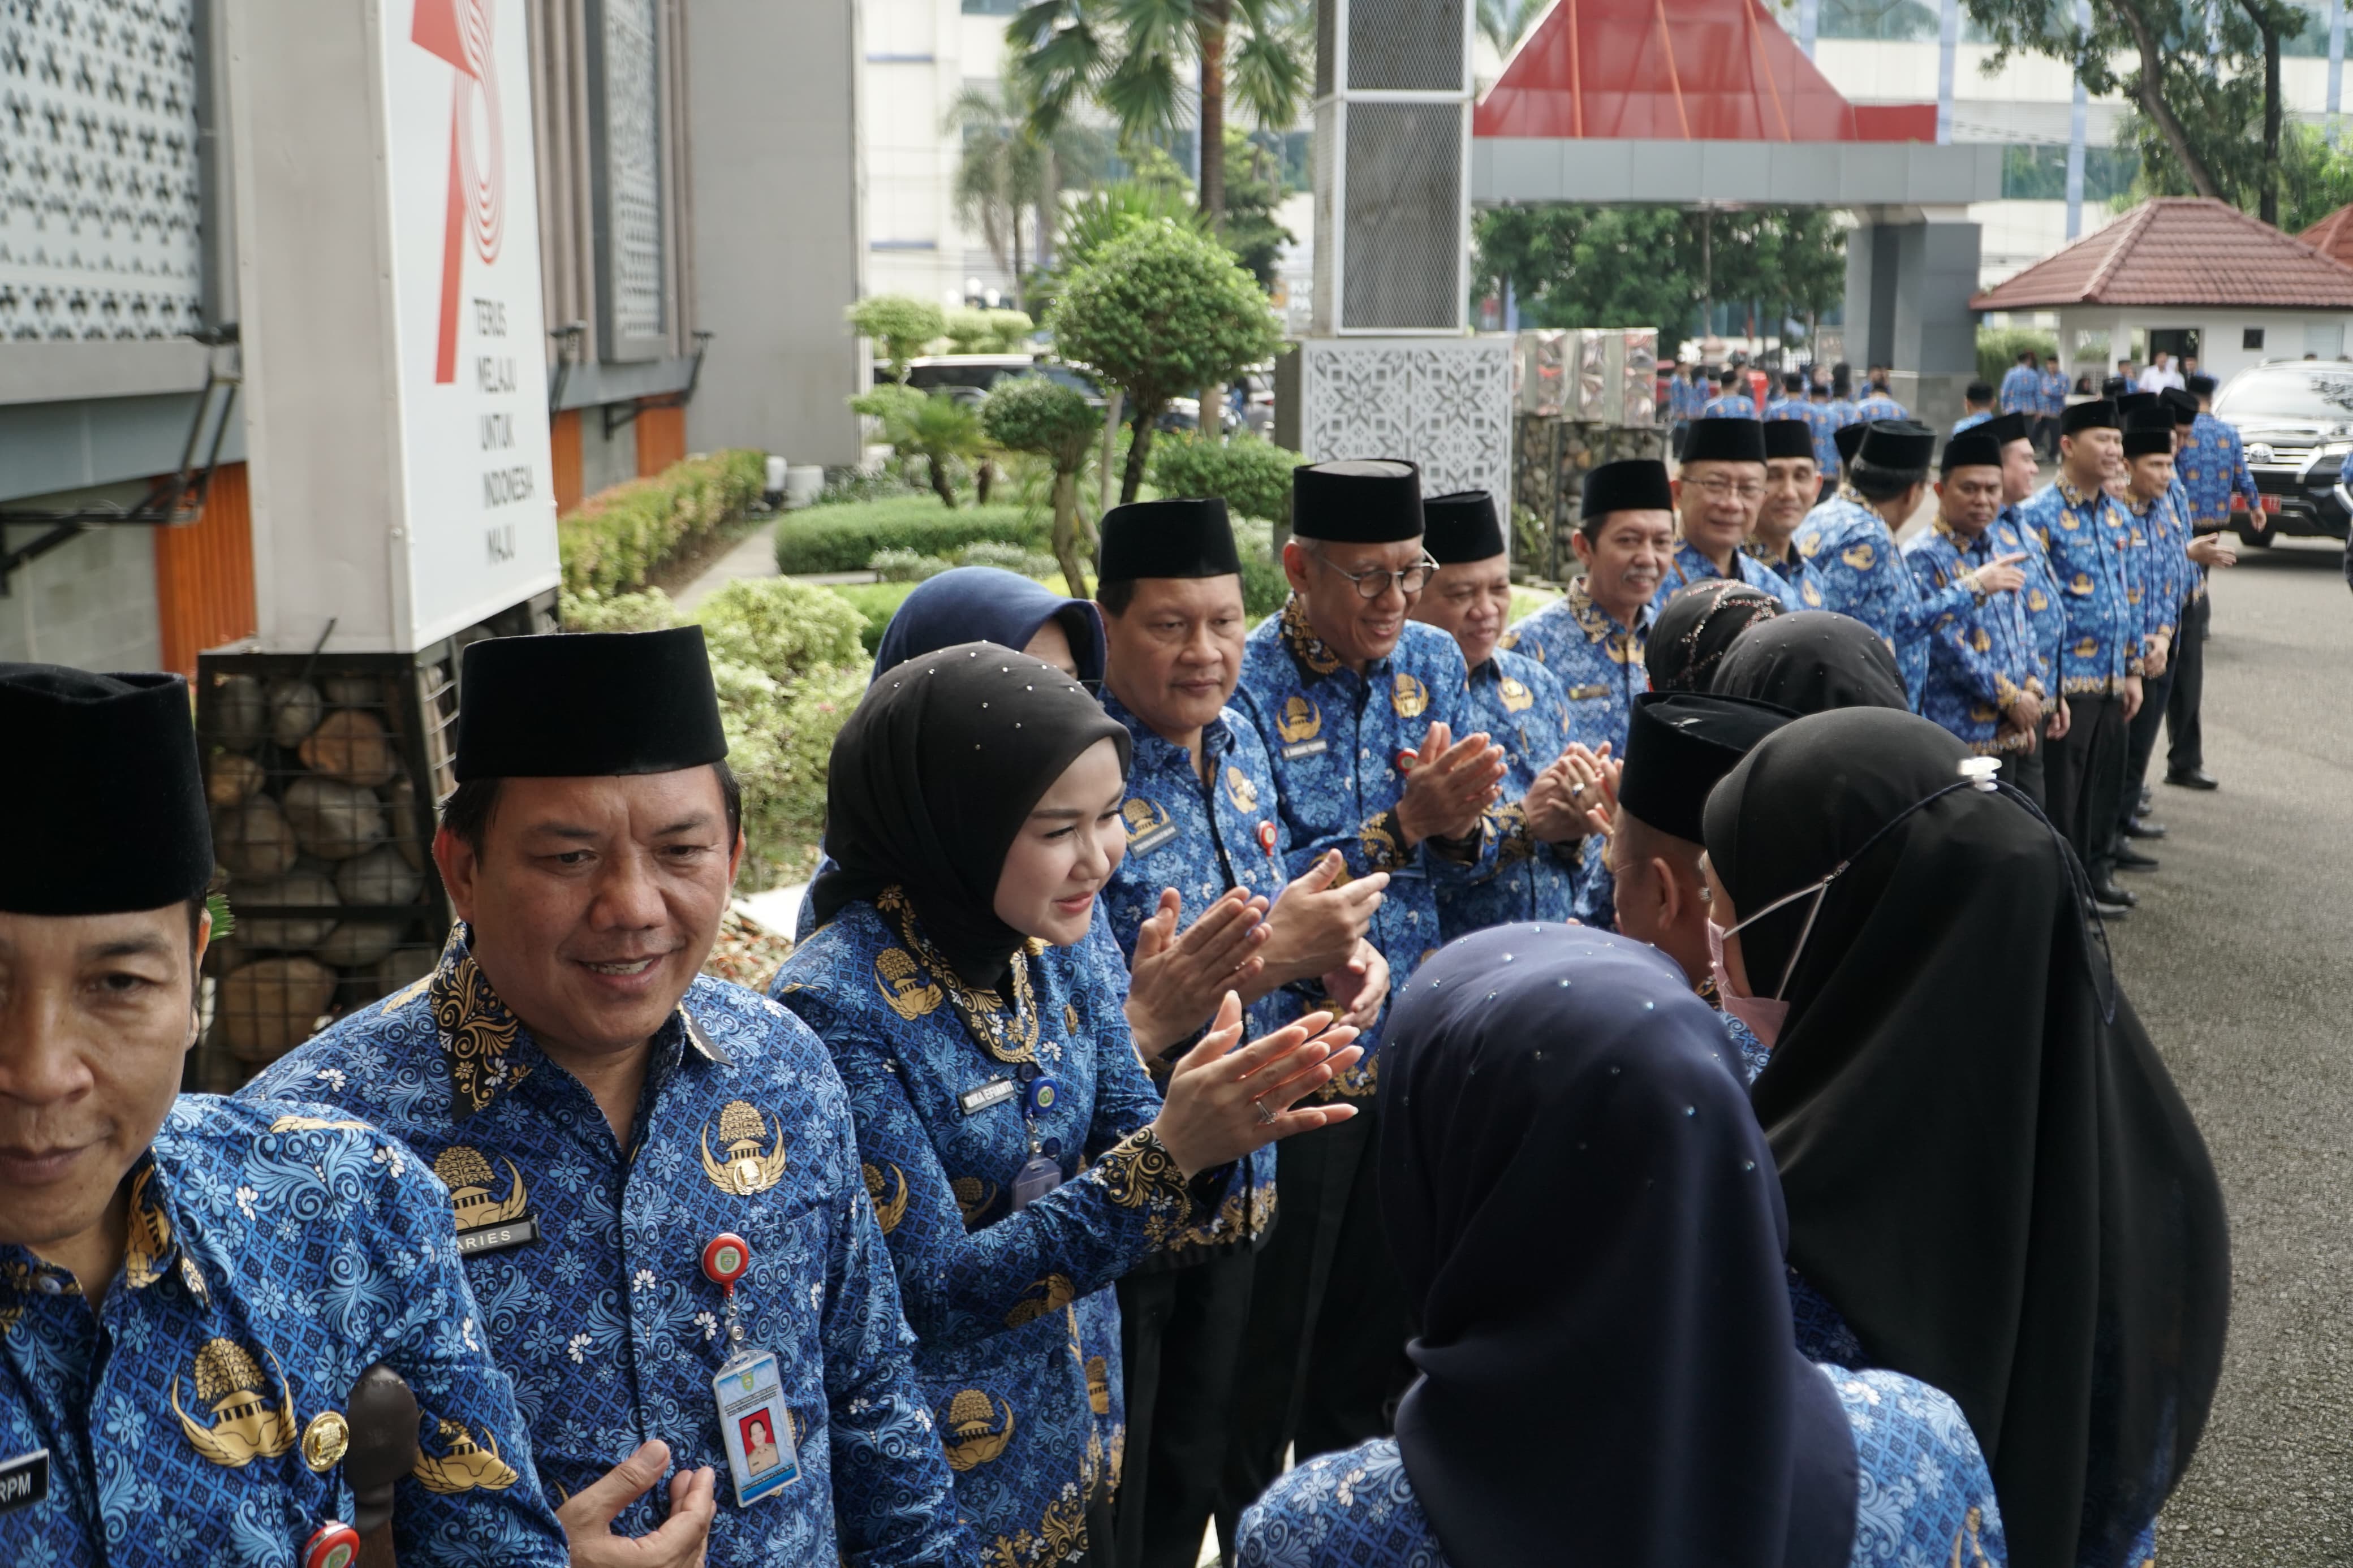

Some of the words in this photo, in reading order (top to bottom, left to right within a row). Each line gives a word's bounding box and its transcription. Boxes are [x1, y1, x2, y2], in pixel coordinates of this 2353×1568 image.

[473, 299, 507, 338] TERUS
[477, 356, 516, 393] MELAJU
[480, 414, 515, 451] UNTUK
[484, 465, 535, 509] INDONESIA
[487, 524, 515, 565] MAJU
